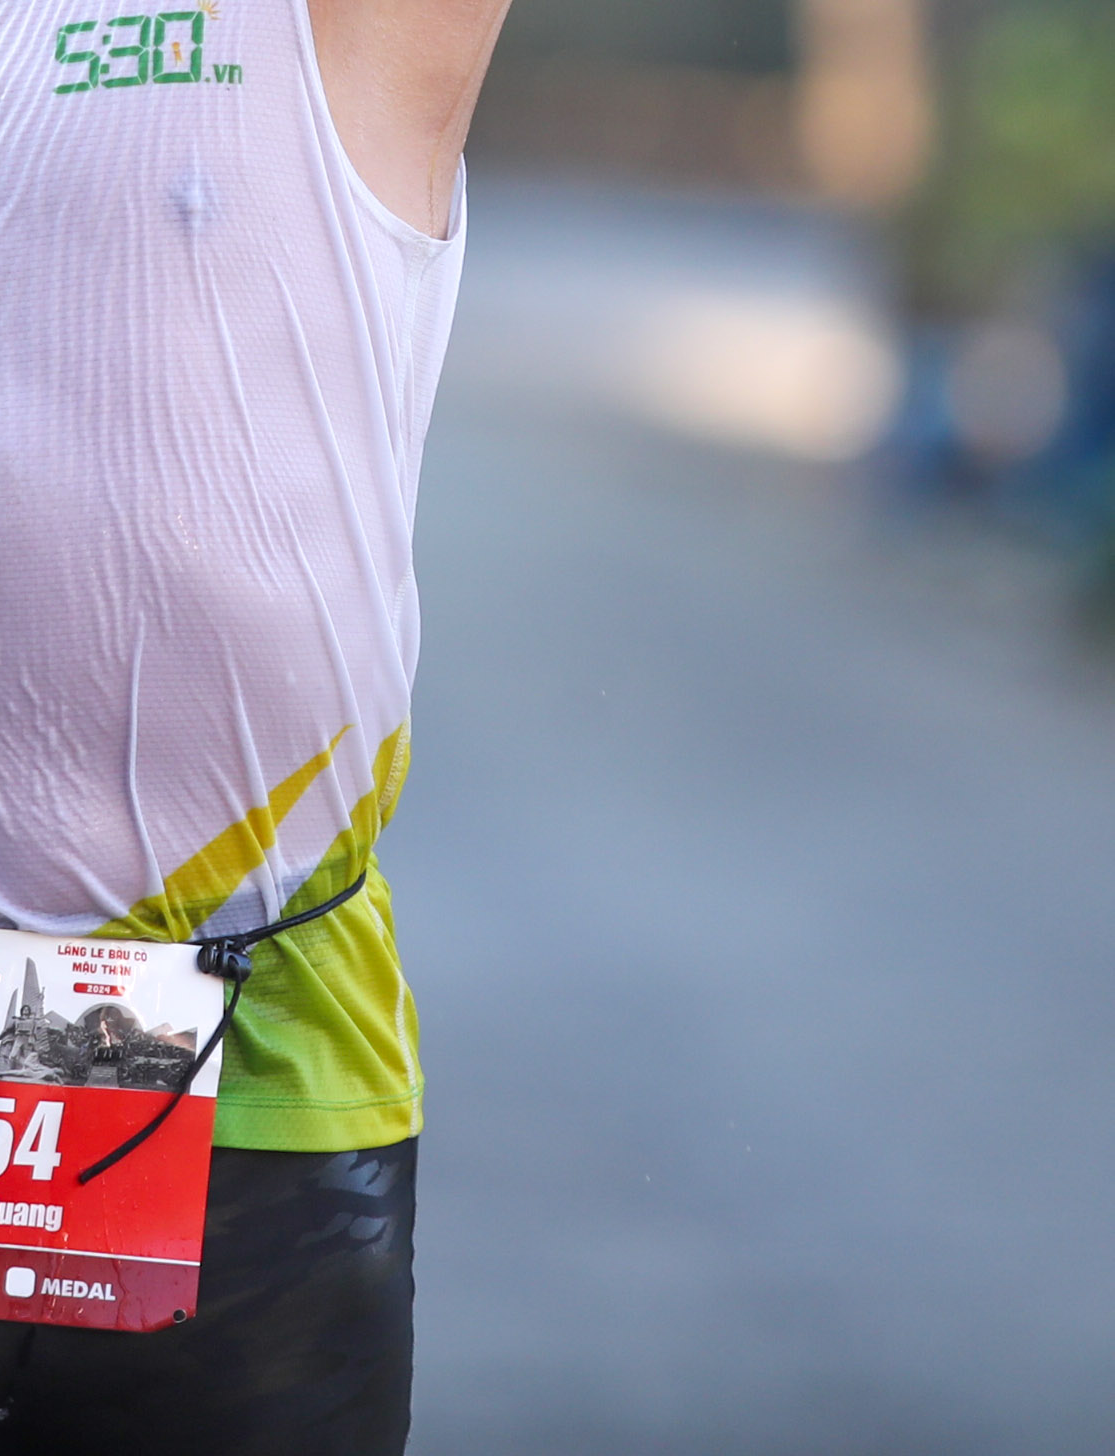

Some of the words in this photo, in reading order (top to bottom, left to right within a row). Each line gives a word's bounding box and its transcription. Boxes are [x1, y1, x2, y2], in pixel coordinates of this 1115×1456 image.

[90, 947, 105, 959] LE
[86, 984, 112, 995] 2024
[39, 1277, 117, 1301] MEDAL
